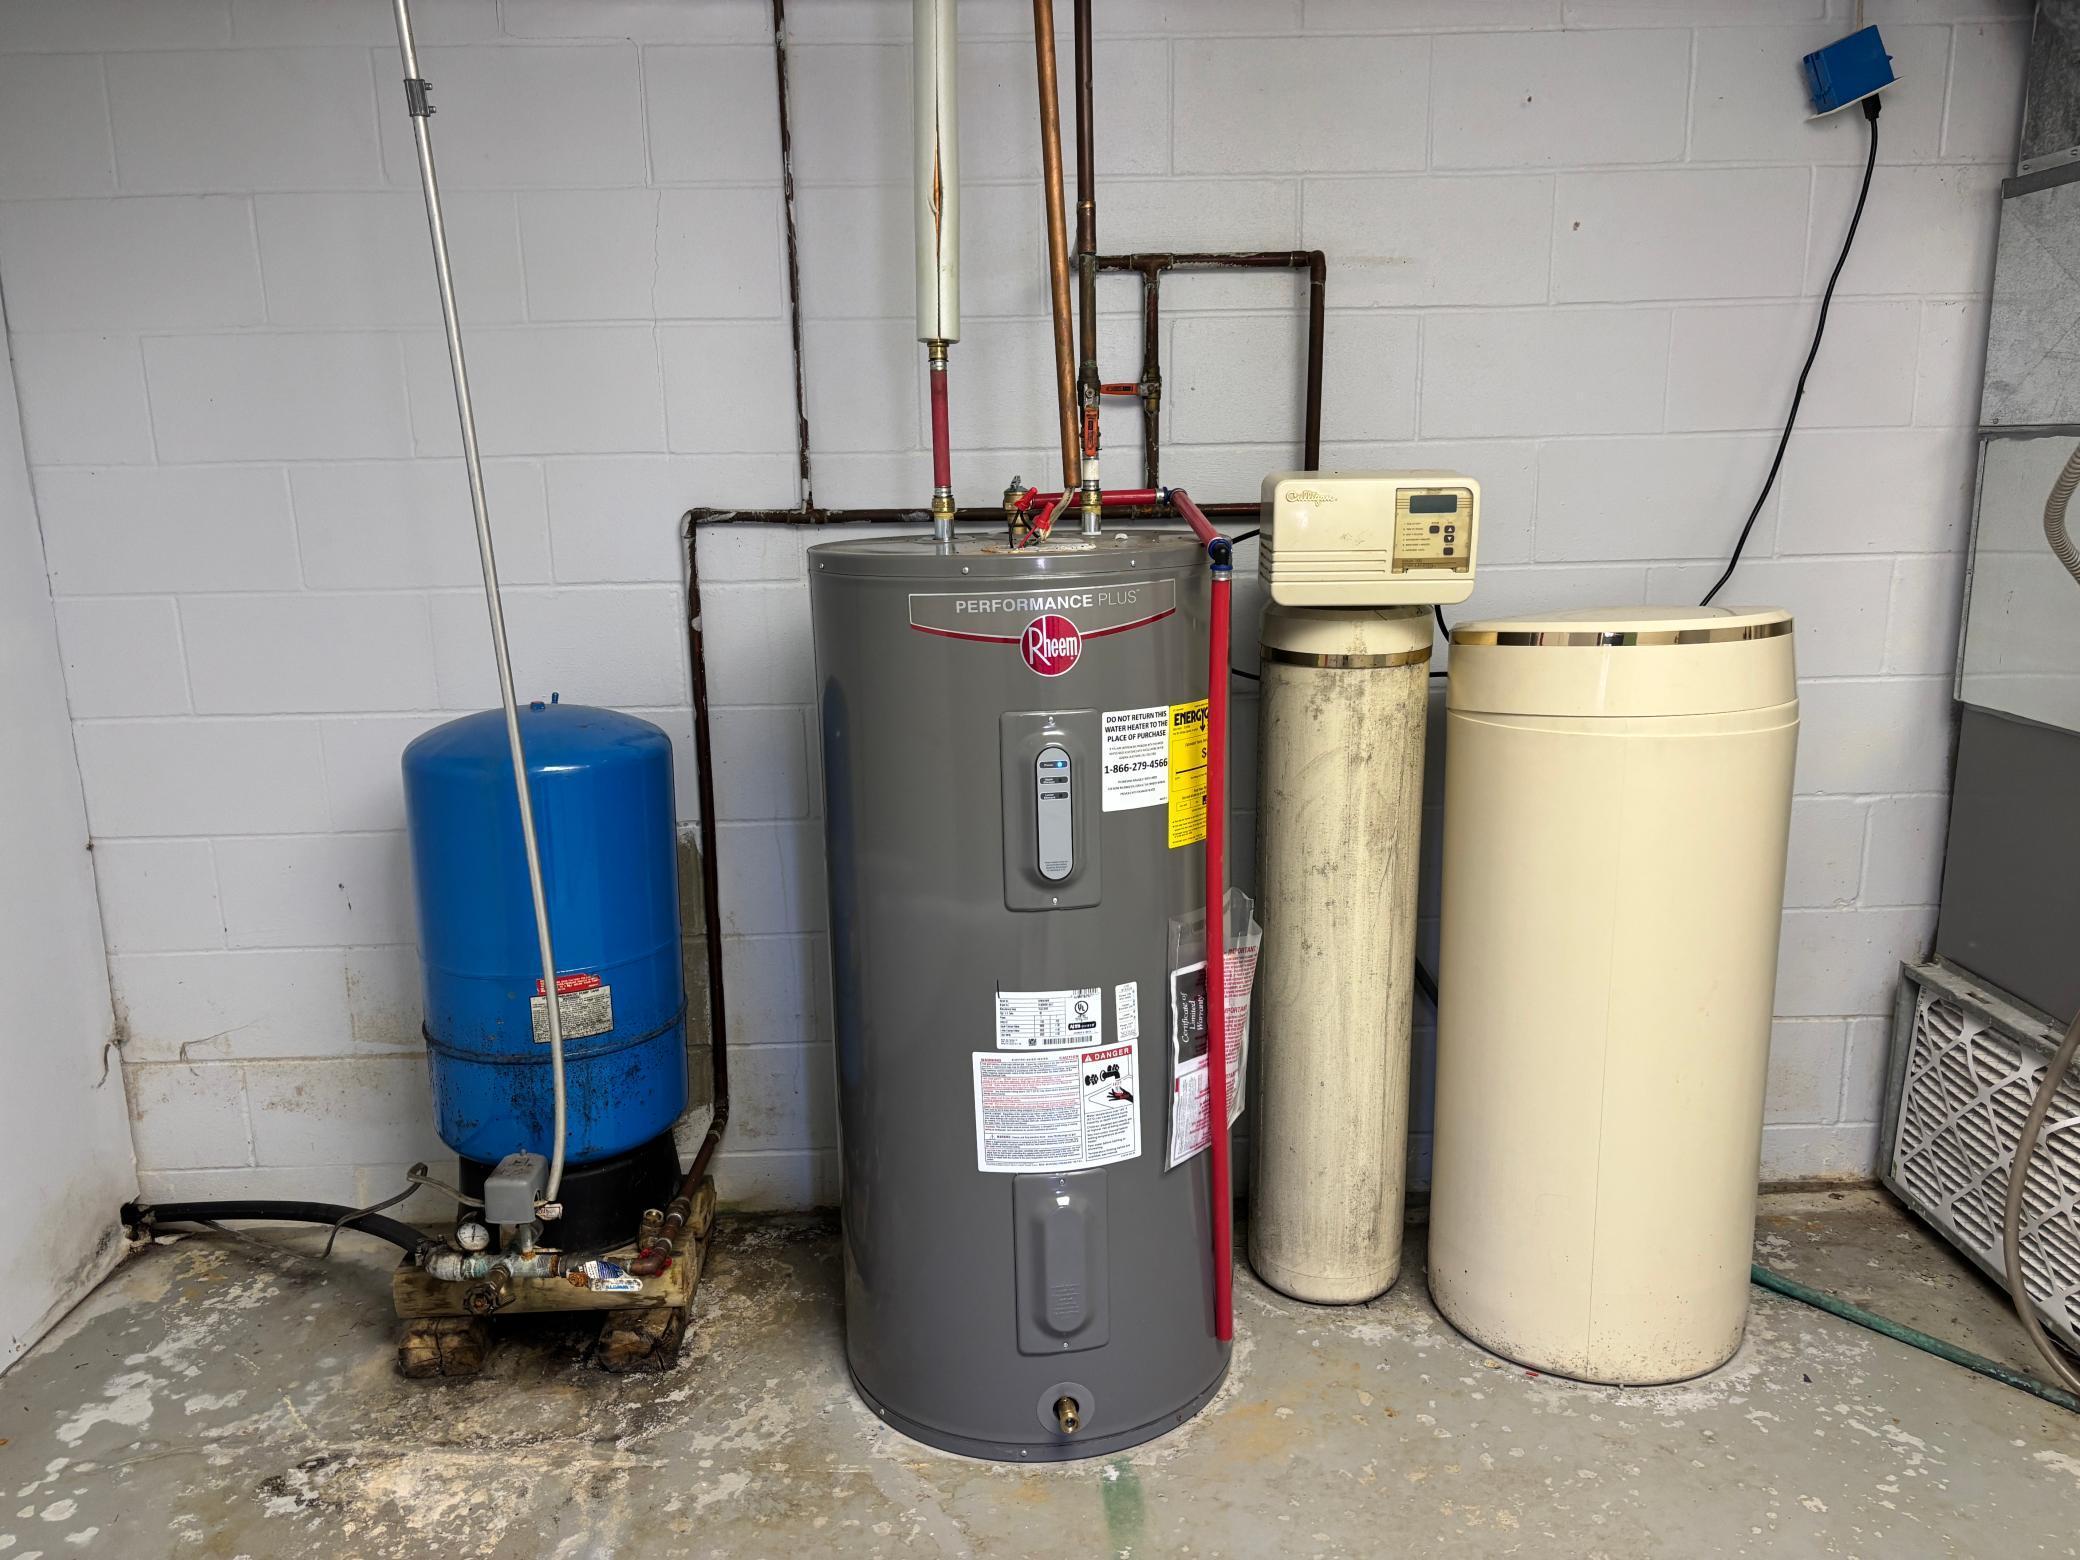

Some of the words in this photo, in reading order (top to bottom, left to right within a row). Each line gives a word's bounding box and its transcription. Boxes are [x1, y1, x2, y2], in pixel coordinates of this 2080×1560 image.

[955, 594, 1093, 613] PERFORMANCE
[1028, 615, 1078, 666] Rheem
[1117, 714, 1131, 722] NOT
[1131, 712, 1154, 721] RETURN
[1155, 710, 1167, 718] THIS
[1105, 724, 1126, 733] WATER
[1127, 722, 1149, 731] HEATER
[1158, 719, 1168, 728] THE
[1107, 733, 1127, 742] PLACE
[1128, 732, 1136, 740] OF
[1137, 729, 1166, 740] PURCHASE
[1104, 757, 1168, 774] 1-866-279-4566
[1180, 992, 1187, 1001] of
[1181, 1002, 1190, 1043] Certificate
[1188, 1000, 1196, 1030] Limited
[1094, 1047, 1130, 1060] DANGER
